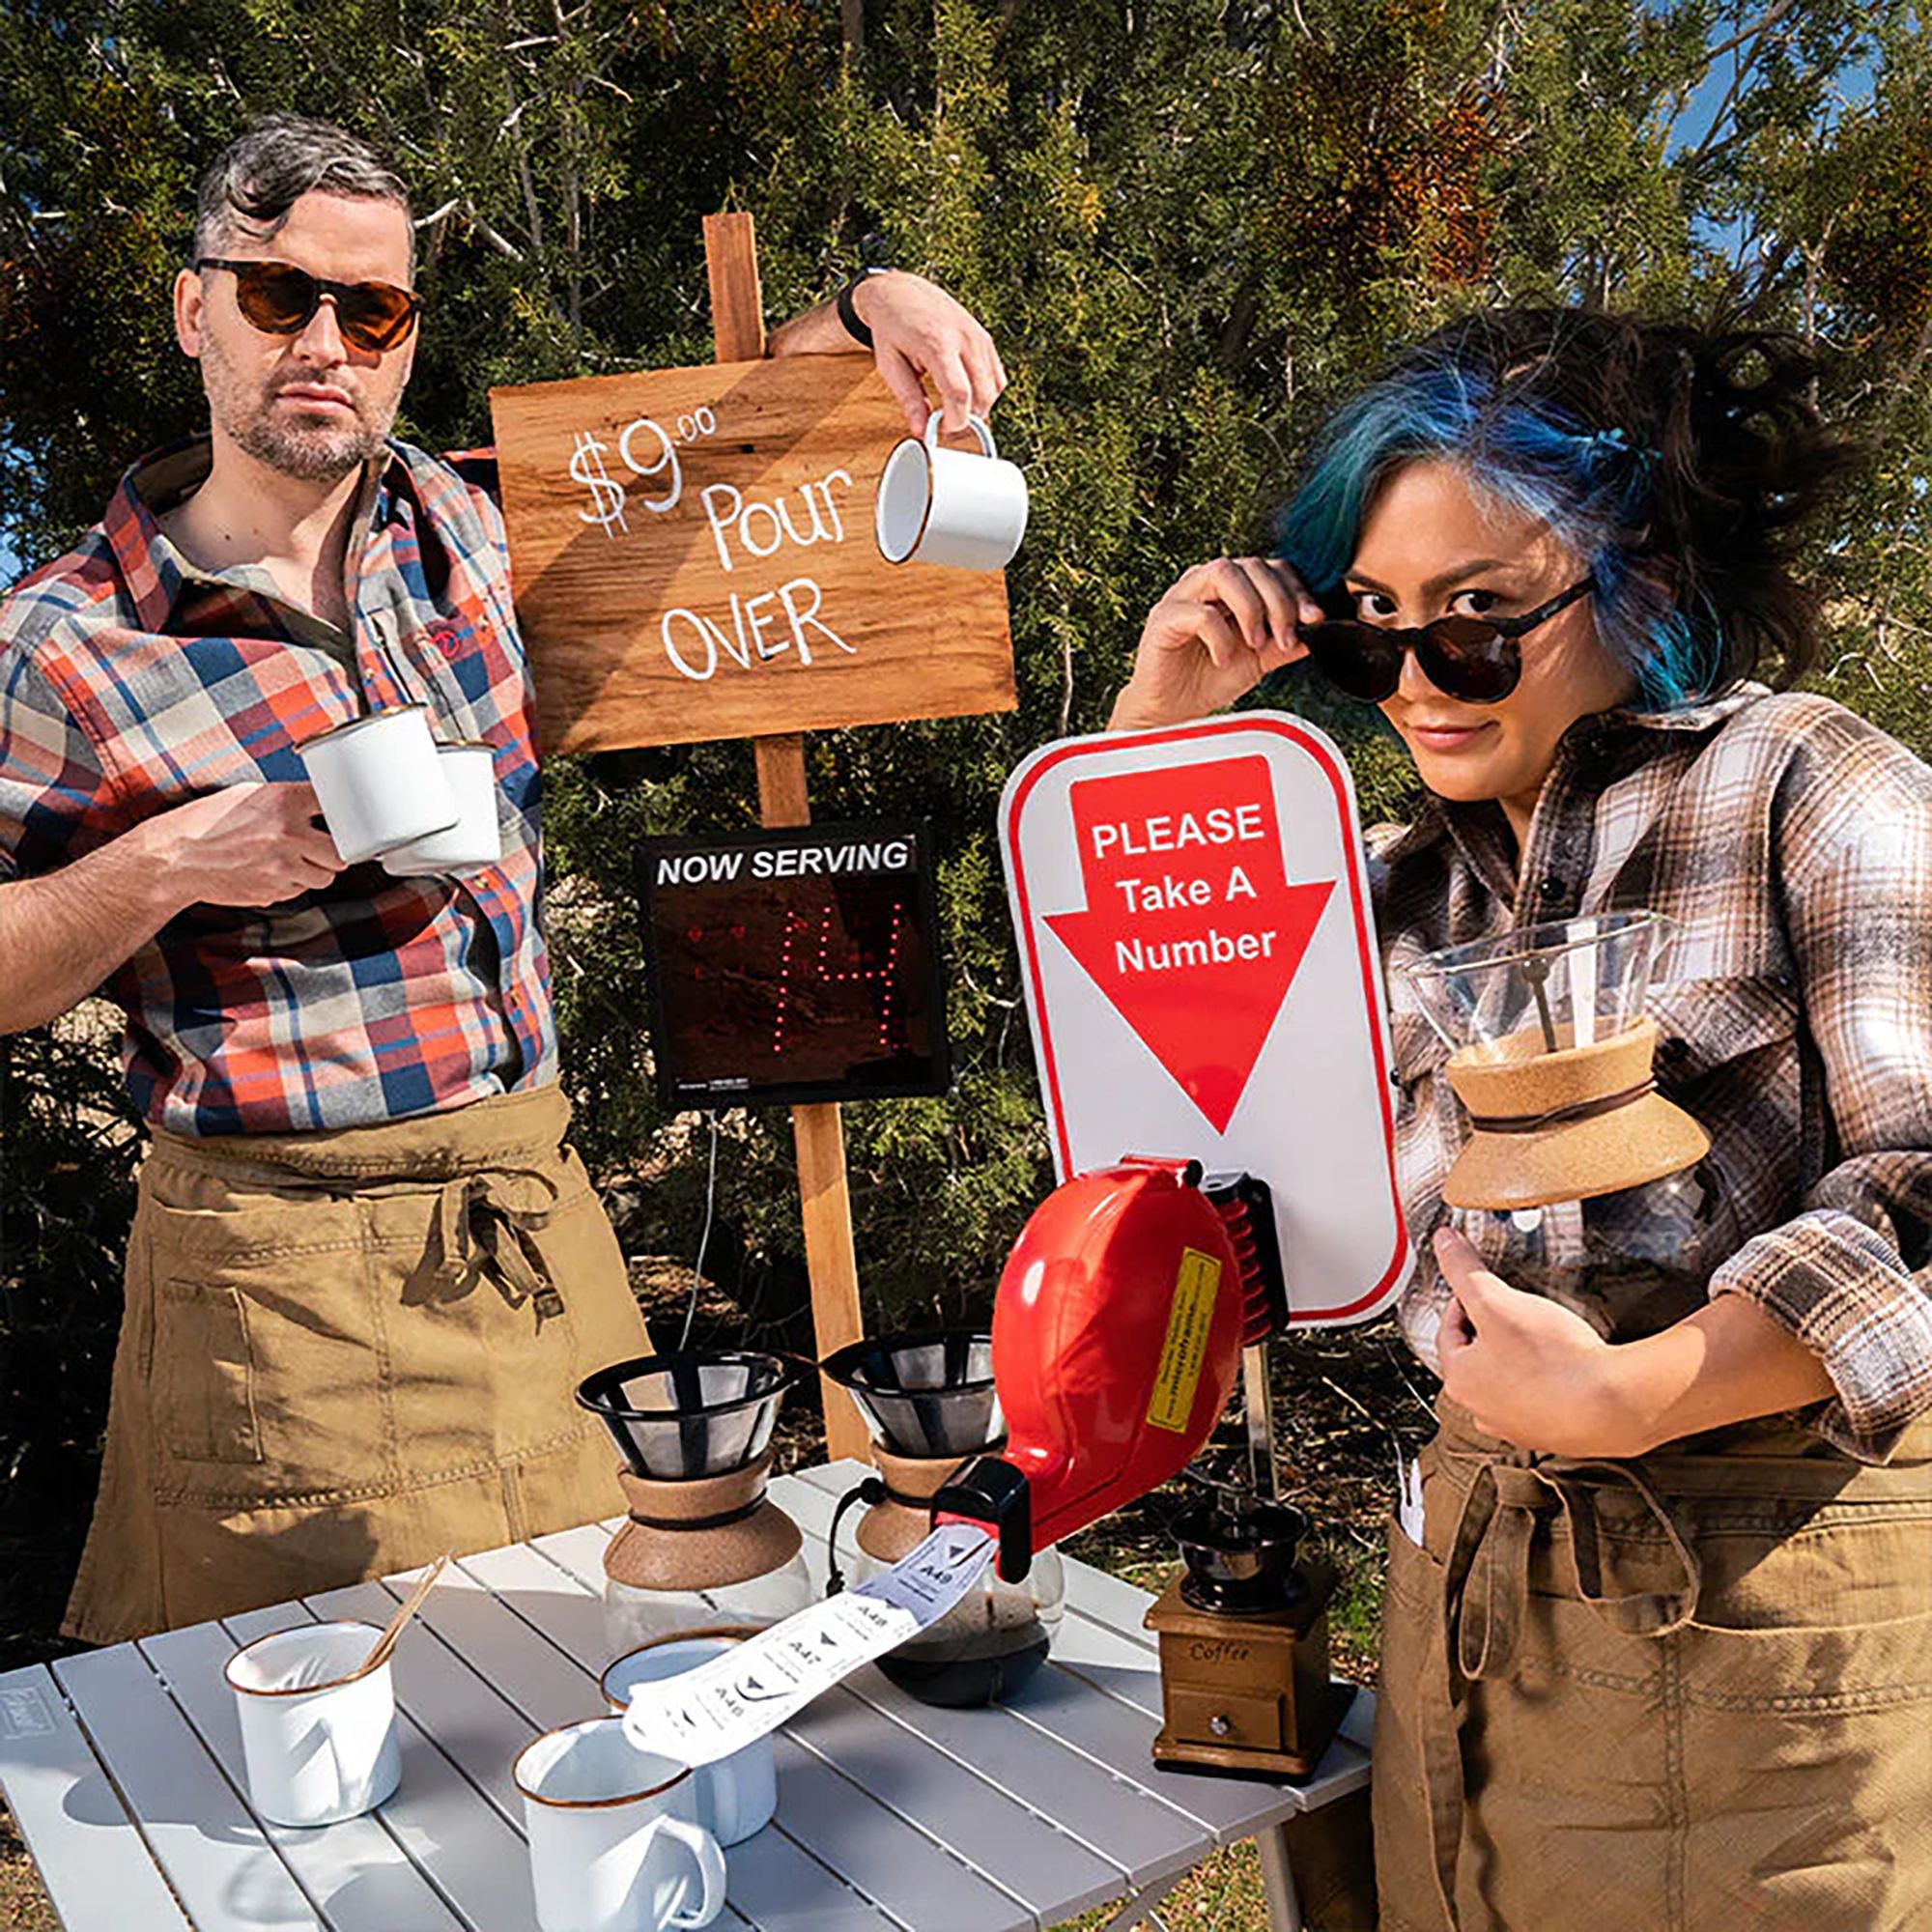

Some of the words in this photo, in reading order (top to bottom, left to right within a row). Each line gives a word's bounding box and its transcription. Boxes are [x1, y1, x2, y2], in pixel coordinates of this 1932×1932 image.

[699, 469, 853, 572] Pour
[660, 578, 857, 681] OVER
[1091, 804, 1264, 860] PLEASE
[657, 851, 743, 885] NOW
[751, 841, 909, 878] SERVING
[1115, 875, 1211, 913] Take
[1225, 866, 1257, 901] A
[1114, 929, 1277, 974] Number
